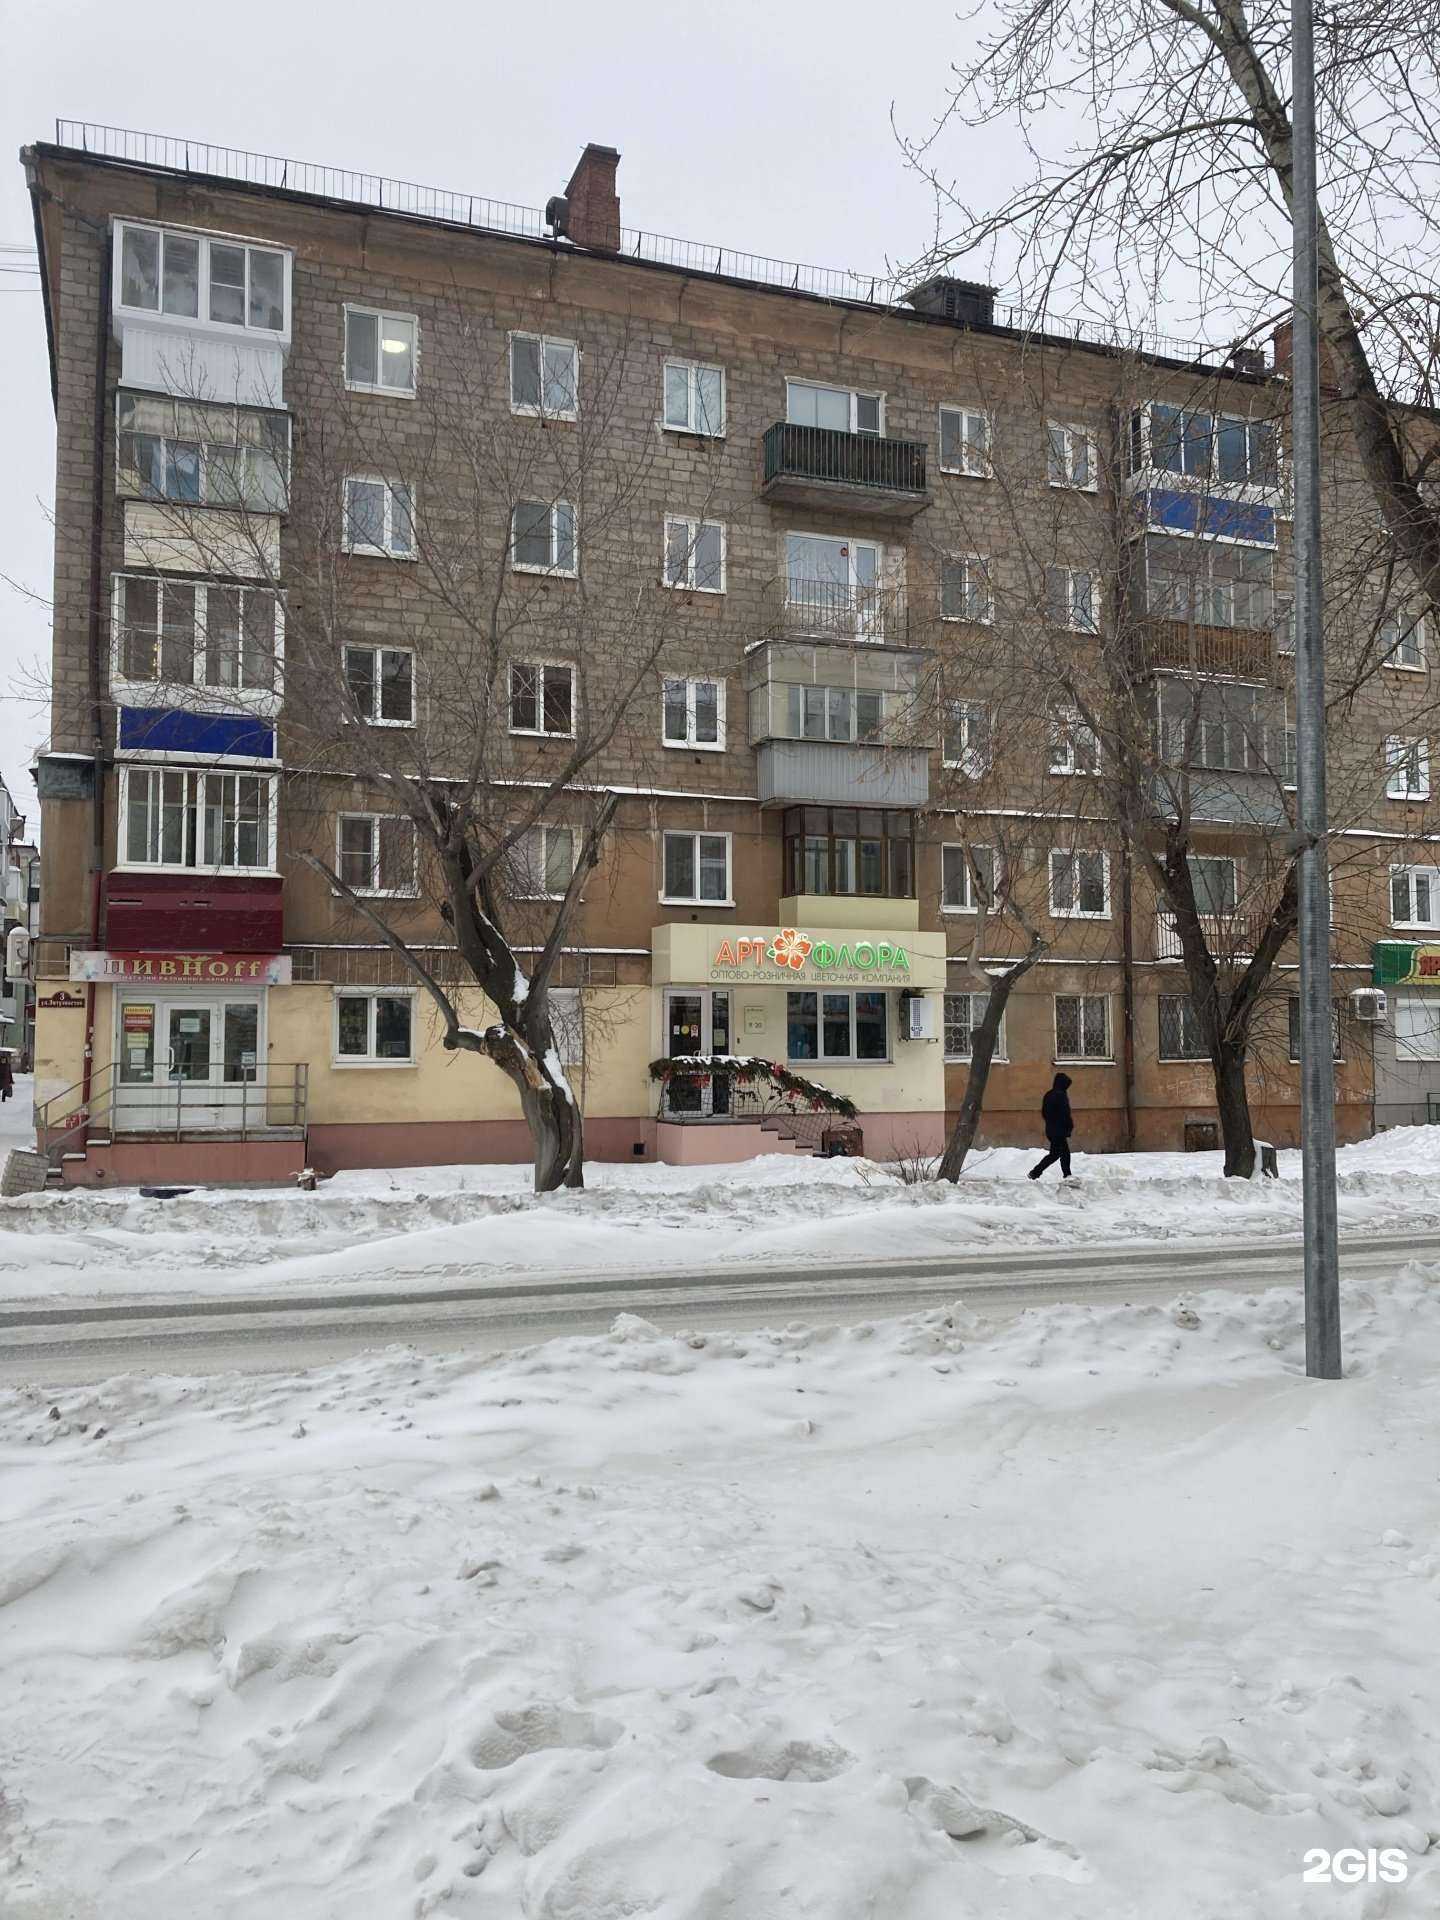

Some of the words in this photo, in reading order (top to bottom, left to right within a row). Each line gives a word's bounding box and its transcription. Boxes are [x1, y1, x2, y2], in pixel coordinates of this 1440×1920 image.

[714, 939, 767, 966] АРТ
[812, 941, 910, 969] ФЛОРА
[711, 969, 806, 980] ОПТОВО-РОЗНИЧНАЯ
[811, 971, 859, 982] ЦВЕТОЧНАЯ
[862, 972, 911, 983] КОМПАНИЯ
